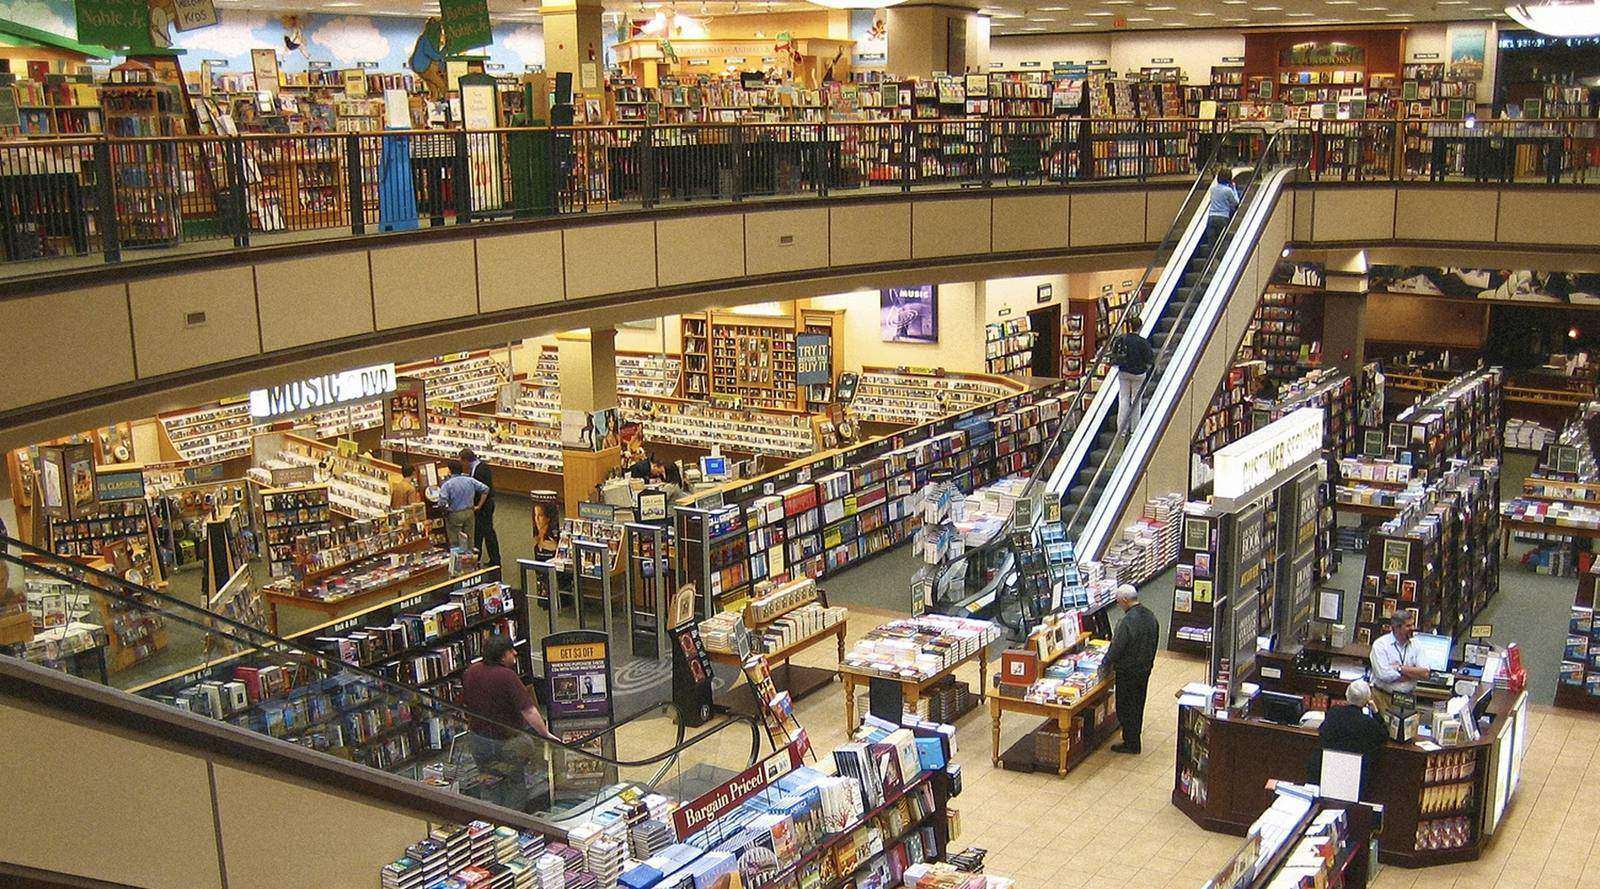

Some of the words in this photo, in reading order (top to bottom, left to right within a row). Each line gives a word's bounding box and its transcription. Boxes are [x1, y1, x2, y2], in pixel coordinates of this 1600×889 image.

[899, 289, 929, 299] MUSIC
[798, 345, 818, 357] TRY
[818, 344, 827, 356] IT
[798, 362, 818, 373] BUY
[818, 361, 827, 372] IT
[269, 373, 338, 416] MUSIC
[361, 368, 388, 396] DVD
[560, 648, 572, 659] GET
[573, 647, 582, 658] $3
[583, 647, 594, 657] OFF
[684, 793, 730, 829] Bargain
[728, 766, 764, 801] Priced
